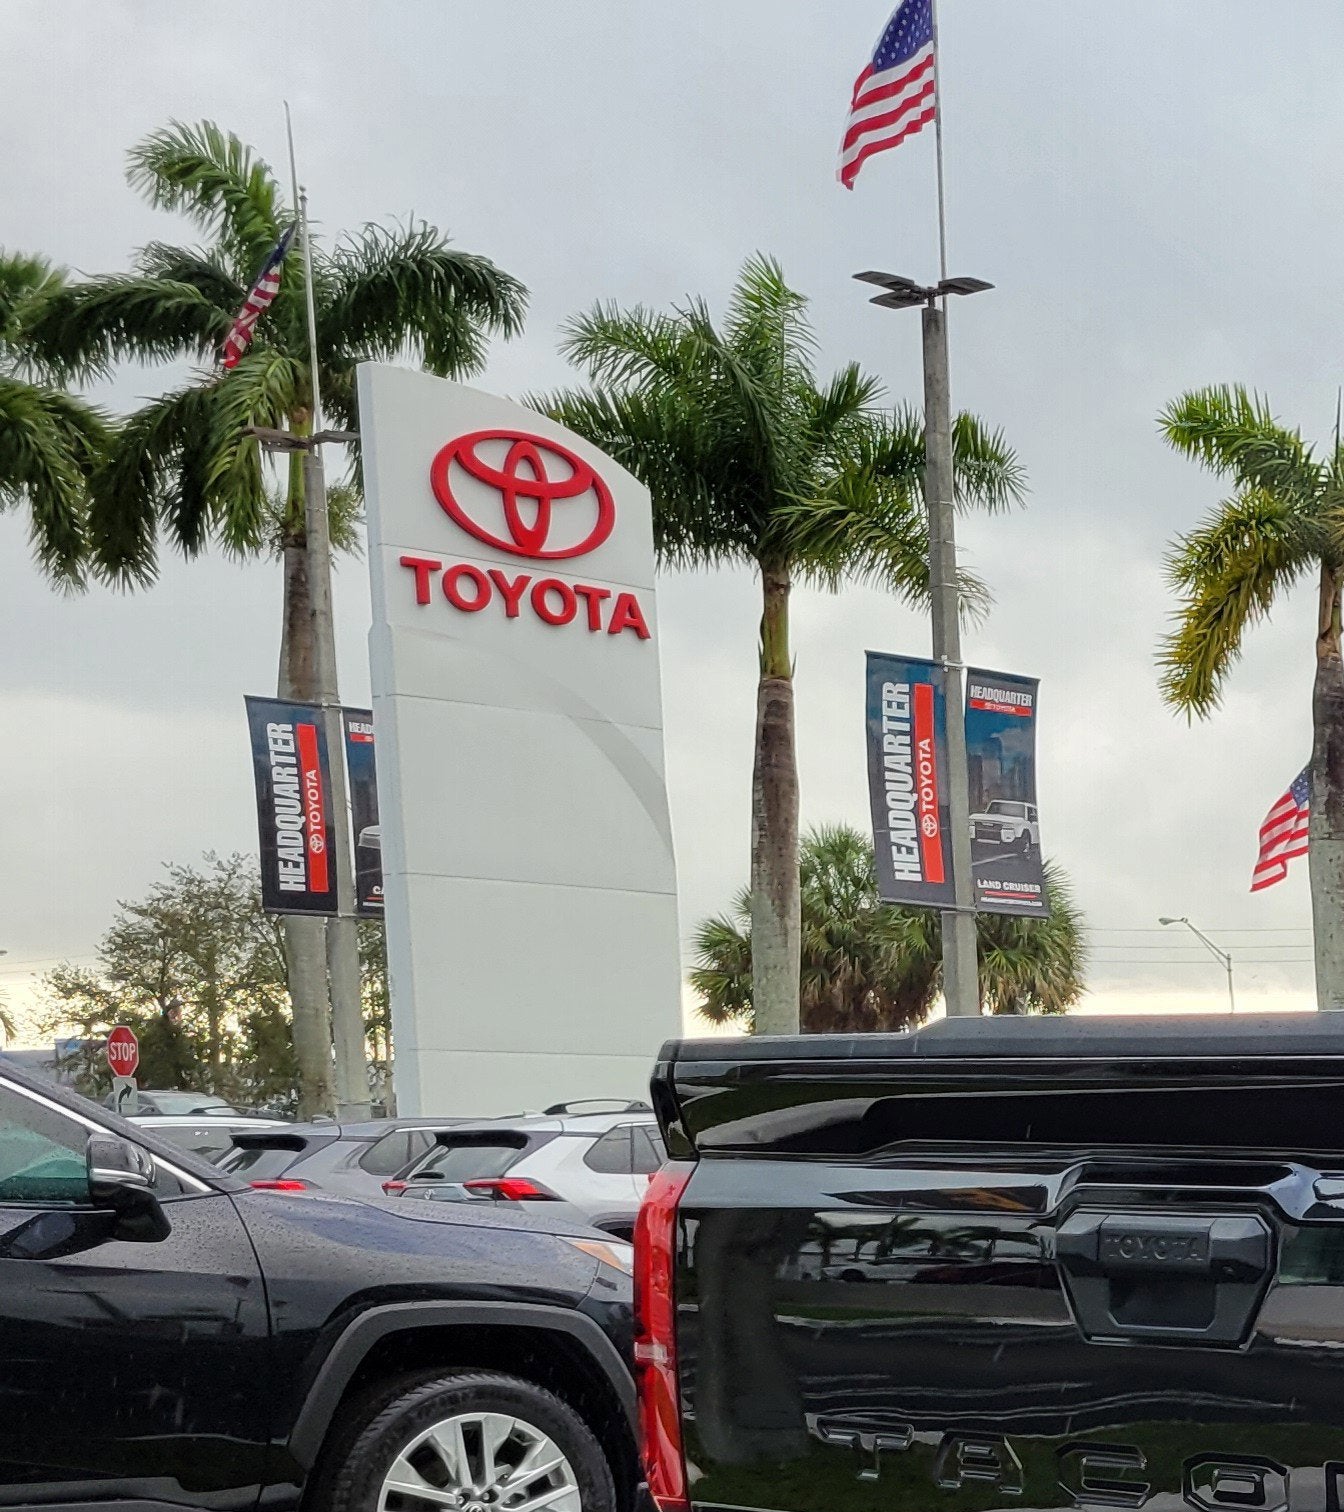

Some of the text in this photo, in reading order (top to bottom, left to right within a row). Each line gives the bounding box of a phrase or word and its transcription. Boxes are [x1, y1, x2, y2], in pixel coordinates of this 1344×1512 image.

[400, 556, 651, 639] TOYOTA
[970, 685, 1032, 706] HEADQUARTER
[306, 769, 321, 832] TOYOTA
[882, 682, 923, 882] HEADQUARTER
[918, 738, 935, 812] TOYOTA
[267, 722, 306, 892] HEADQUARTER
[977, 879, 1002, 890] LAND
[110, 1042, 135, 1061] STOP
[1104, 1234, 1205, 1261] TOYOTA
